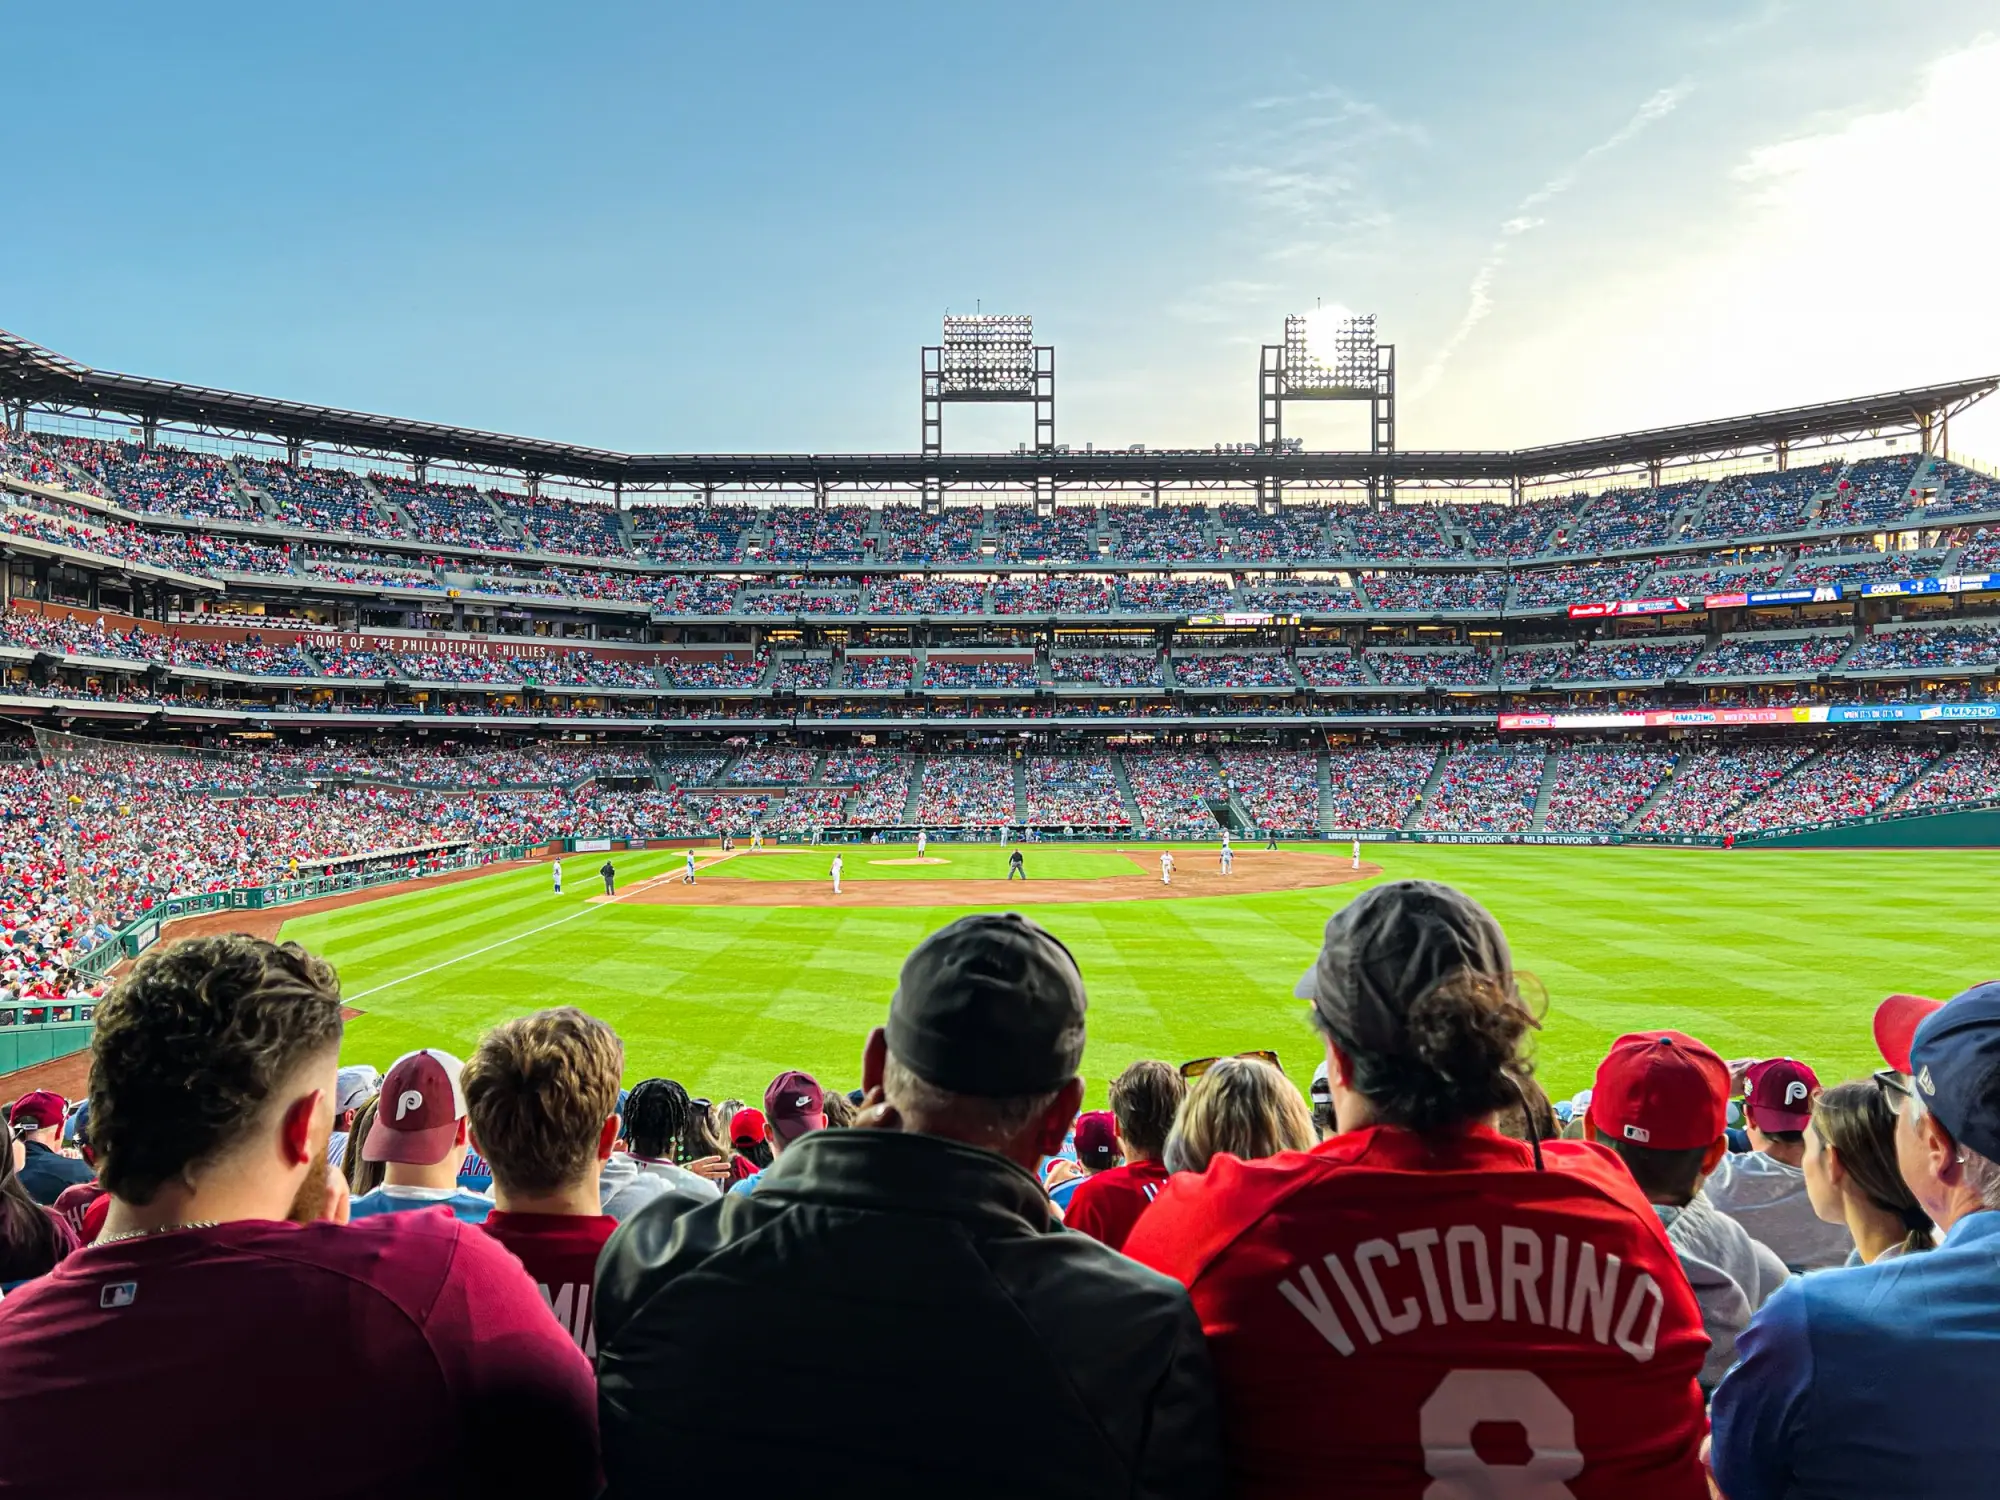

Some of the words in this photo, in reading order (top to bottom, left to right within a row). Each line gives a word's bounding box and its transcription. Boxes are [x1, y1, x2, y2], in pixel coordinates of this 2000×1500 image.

[350, 636, 365, 648] OF
[402, 639, 488, 655] PHILADELPHIA
[1943, 706, 1996, 717] AMAZING
[1674, 712, 1716, 722] AMAZING
[1328, 832, 1357, 841] LISCIO'S
[1359, 832, 1387, 841] BAKERY
[1438, 836, 1458, 844] MLB
[1459, 835, 1505, 844] NETWORK
[1524, 836, 1544, 844] MLB
[1546, 836, 1593, 845] NETWORK
[1277, 1224, 1664, 1363] VICTORINO
